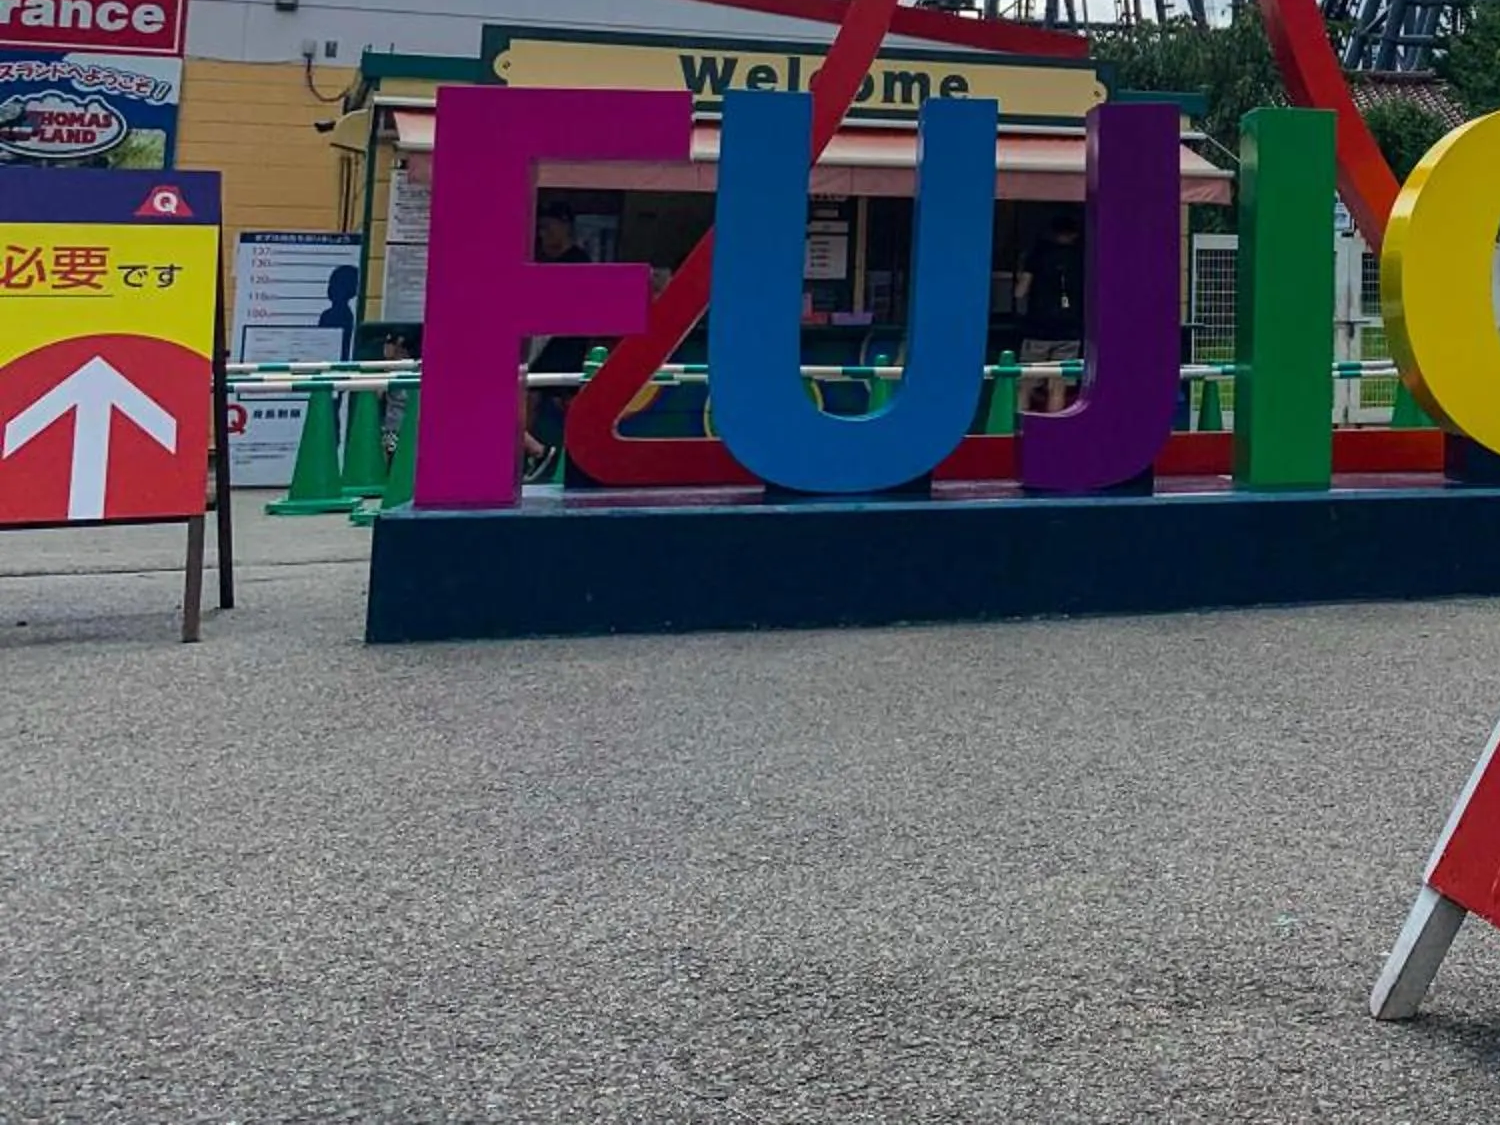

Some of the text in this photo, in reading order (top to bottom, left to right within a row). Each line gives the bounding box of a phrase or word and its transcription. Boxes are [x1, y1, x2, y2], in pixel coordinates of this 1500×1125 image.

[679, 55, 969, 103] Welome
[26, 110, 112, 128] THOMAS
[39, 129, 97, 144] LAND
[153, 191, 177, 214] Q
